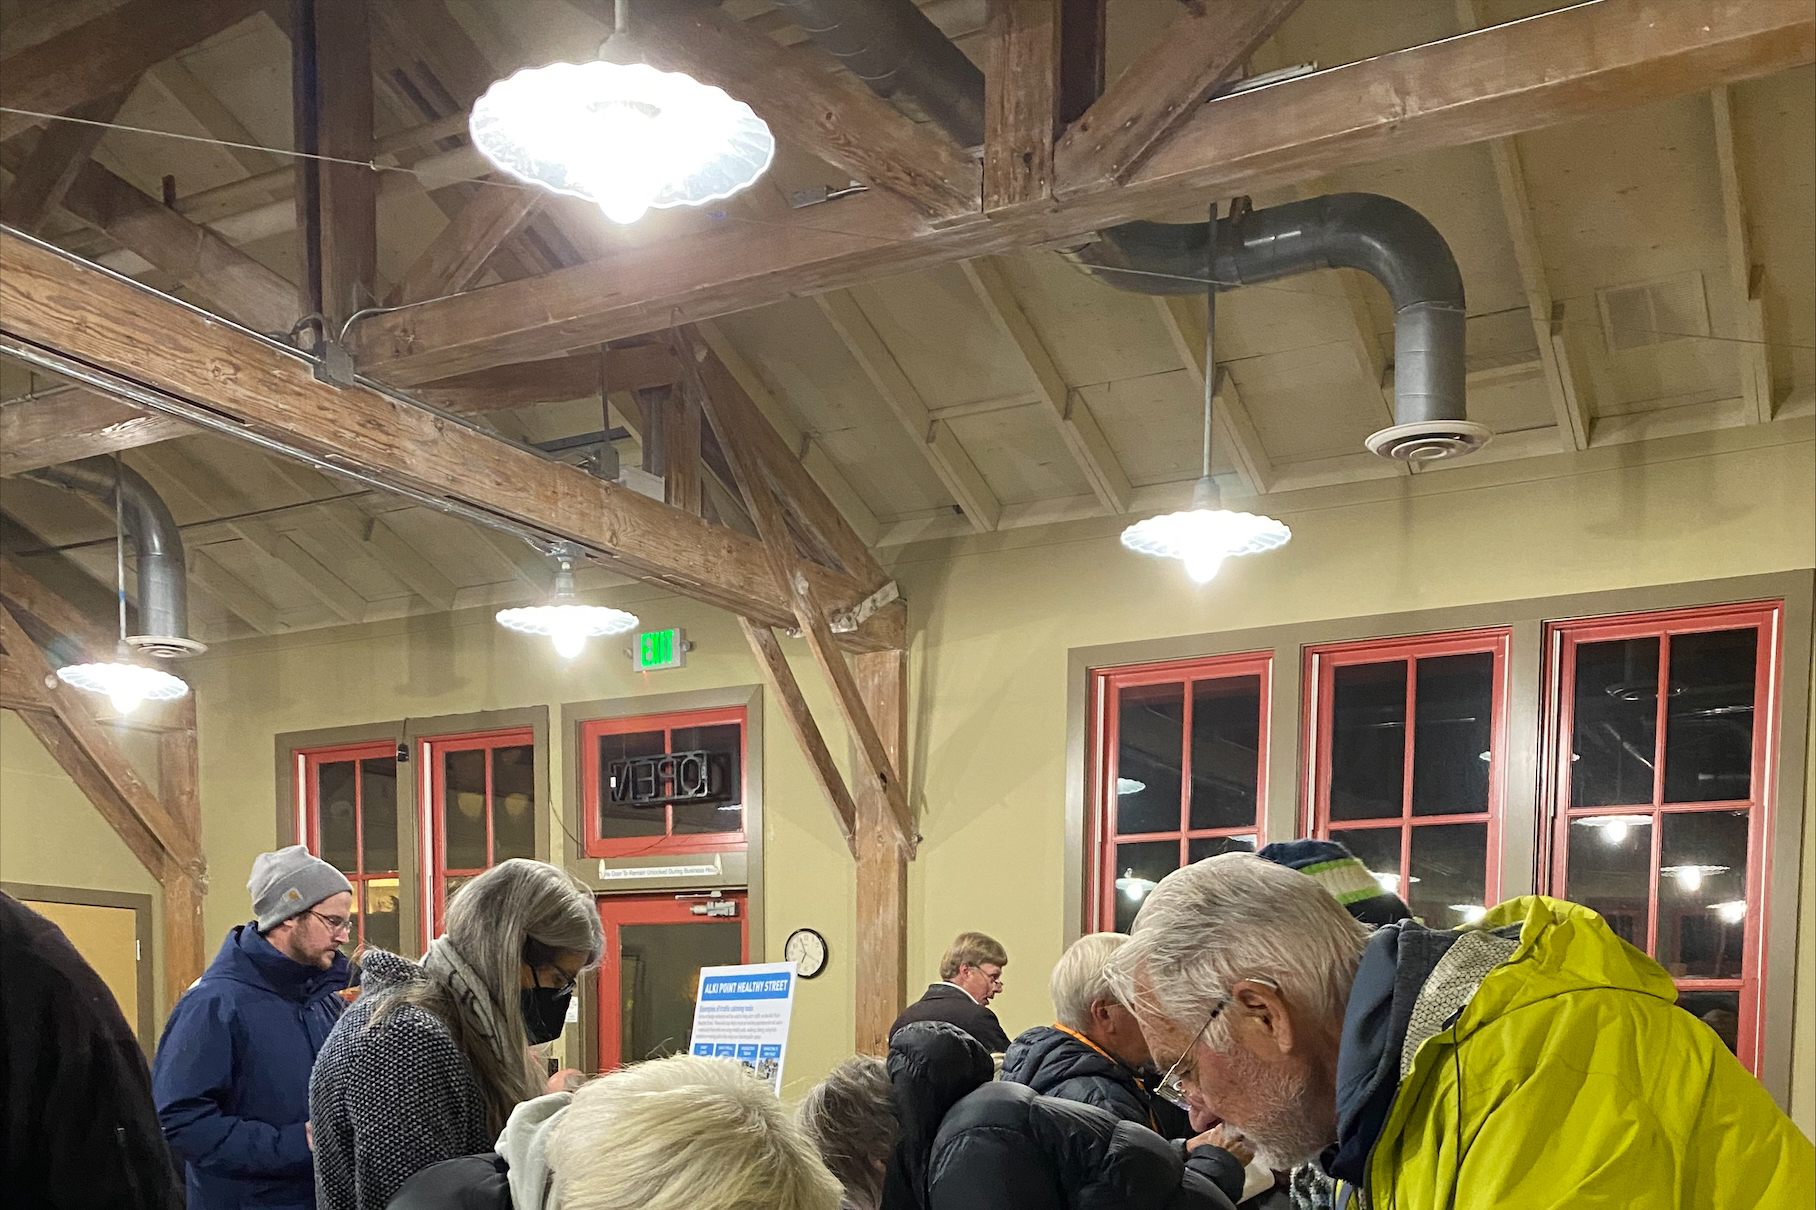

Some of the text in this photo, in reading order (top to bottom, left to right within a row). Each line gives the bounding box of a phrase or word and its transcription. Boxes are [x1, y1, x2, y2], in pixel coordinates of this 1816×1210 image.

[641, 629, 674, 667] EXIT
[705, 980, 788, 994] ALKI POINT HEALTHY STREET
